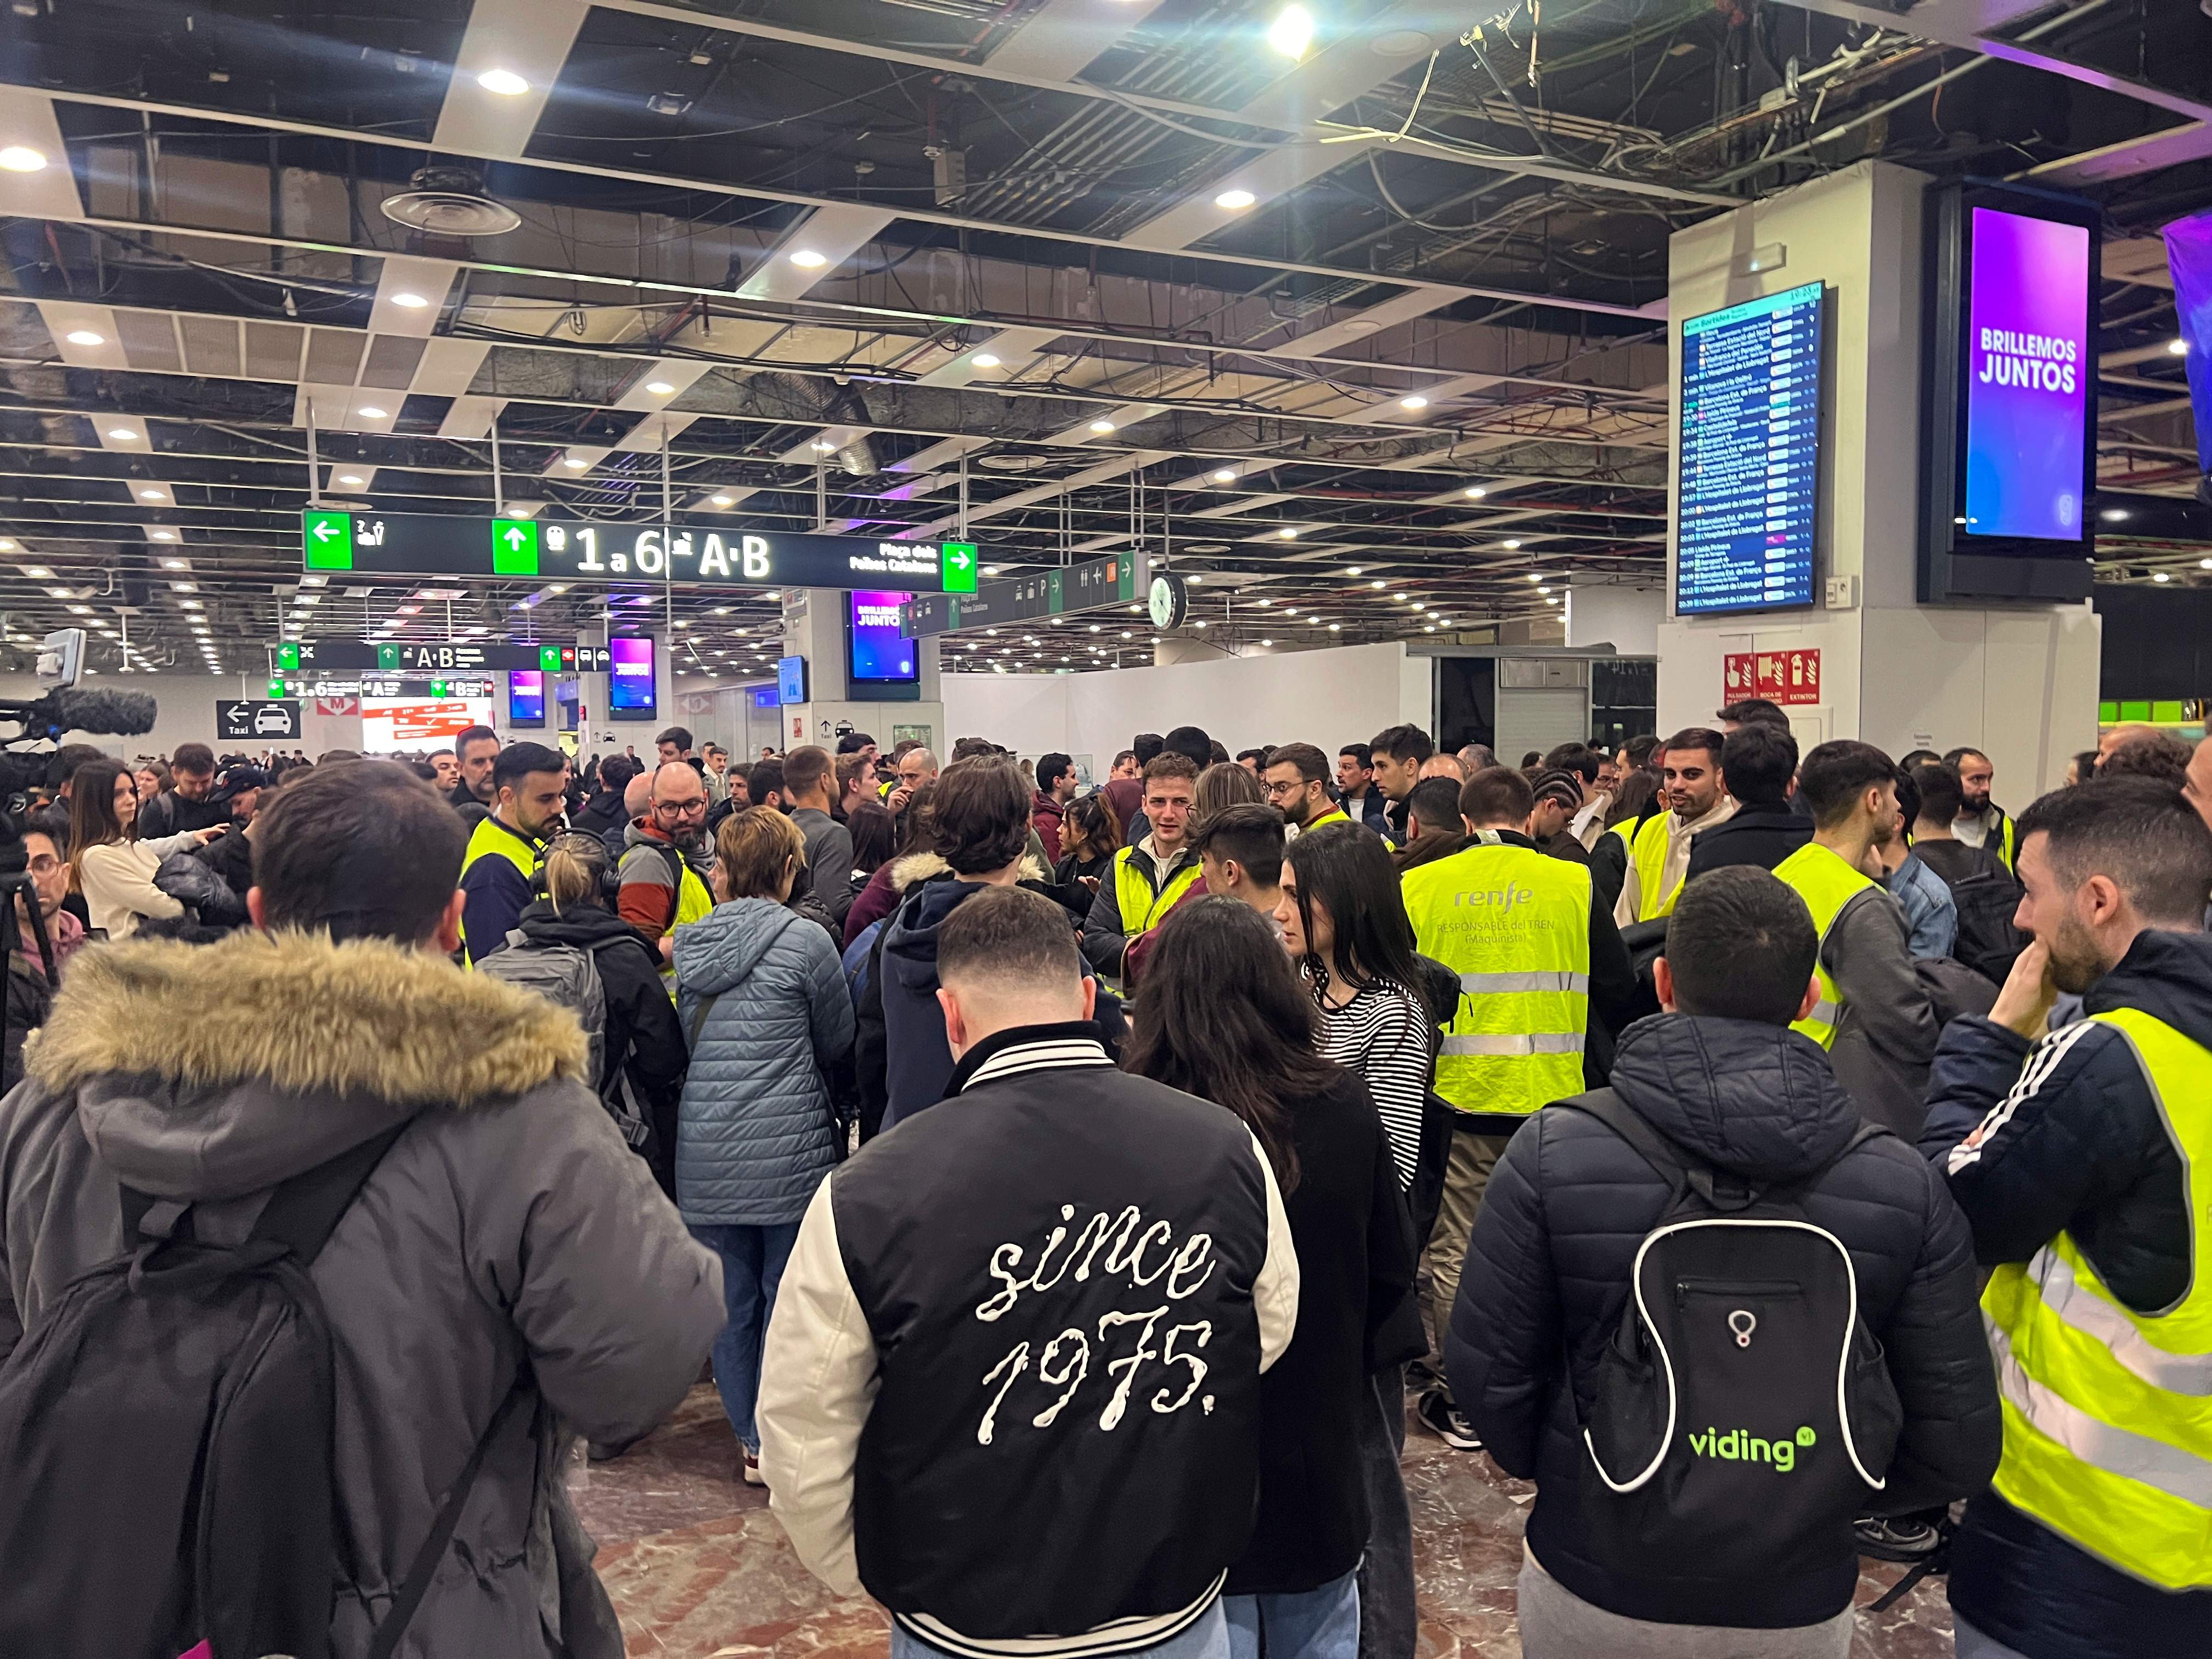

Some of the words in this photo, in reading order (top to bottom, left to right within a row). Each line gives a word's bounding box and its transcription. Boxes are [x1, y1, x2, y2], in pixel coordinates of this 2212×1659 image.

[1981, 328, 2076, 362] BRILLEMOS
[1979, 354, 2076, 394] JUNTOS
[575, 527, 604, 571] 1
[610, 552, 627, 573] a
[635, 531, 663, 574] 6
[857, 615, 900, 627] JUNTO
[228, 726, 249, 735] Taxi
[1454, 879, 1533, 916] renfe
[1437, 921, 1508, 933] RESPONSABLE
[1510, 921, 1526, 930] del
[1528, 920, 1555, 930] TREN
[1465, 934, 1526, 945] (Maquinista)
[975, 1204, 1216, 1321] since
[1689, 1427, 1795, 1472] viding
